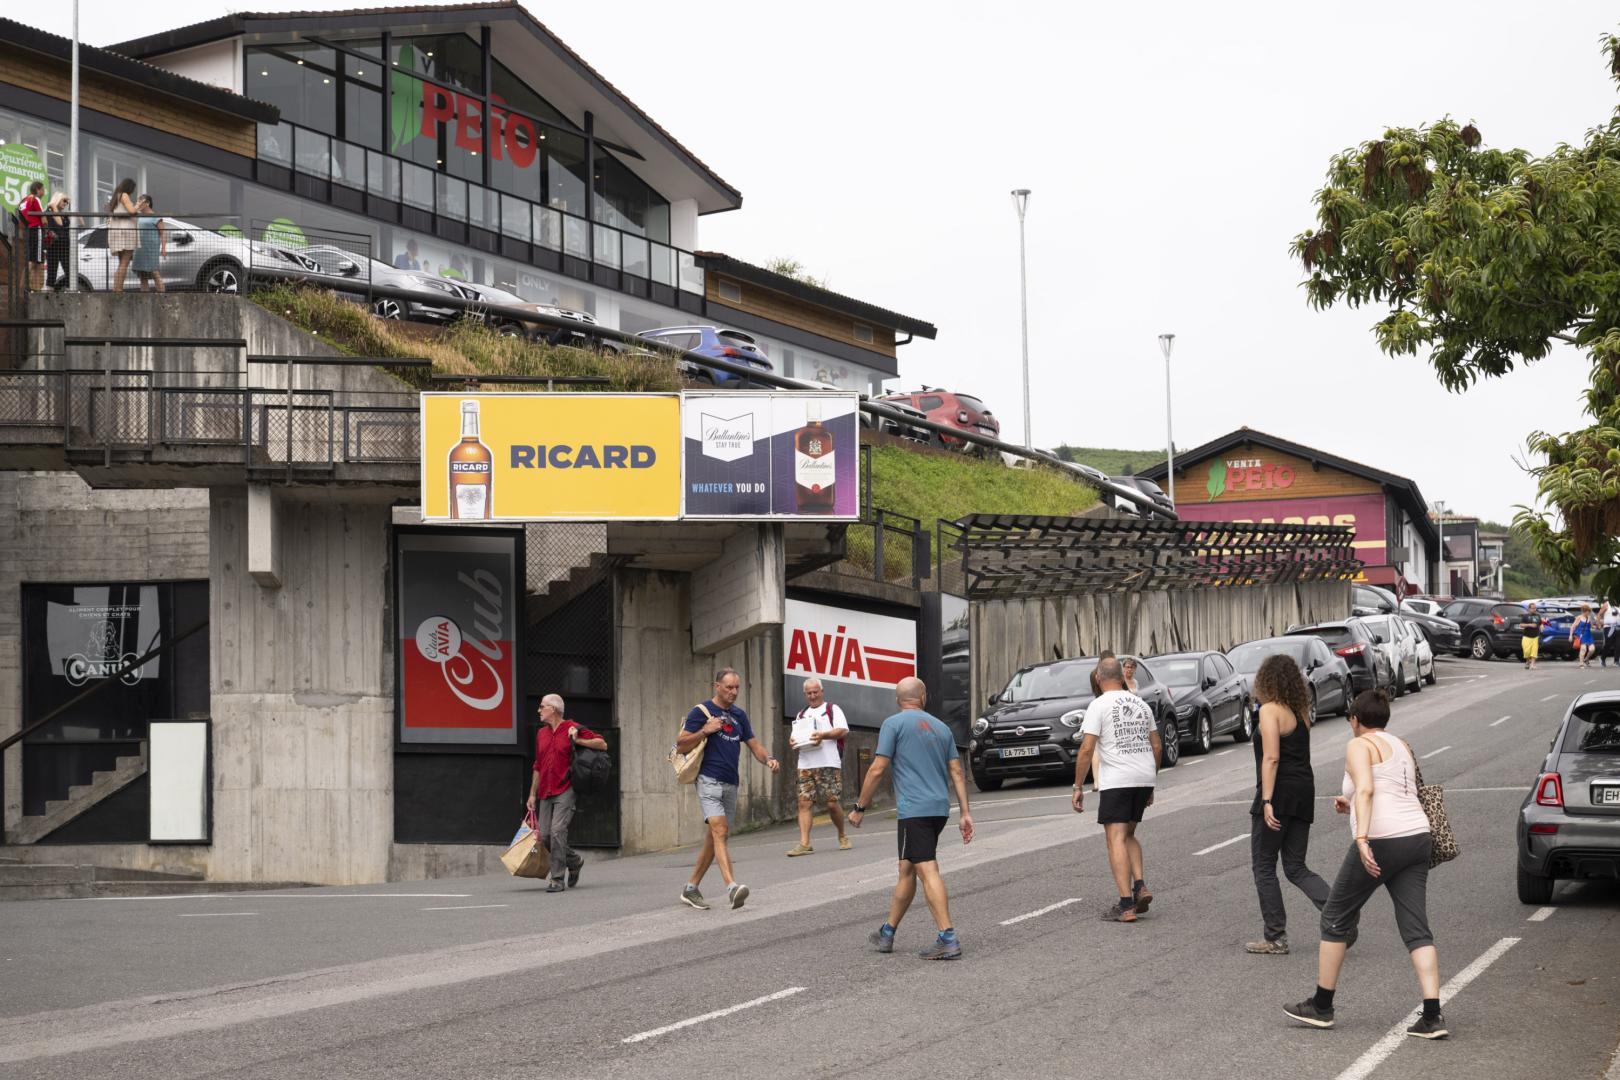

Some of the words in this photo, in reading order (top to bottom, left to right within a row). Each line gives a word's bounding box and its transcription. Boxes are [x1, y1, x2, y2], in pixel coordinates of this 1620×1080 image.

[522, 275, 550, 290] ONLY
[511, 445, 656, 469] RICARD
[453, 463, 488, 471] RICARD
[1226, 459, 1261, 468] VENTA
[692, 483, 733, 493] WHATEVER
[736, 483, 751, 493] YOU
[754, 483, 765, 493] DO
[441, 568, 504, 710] Club
